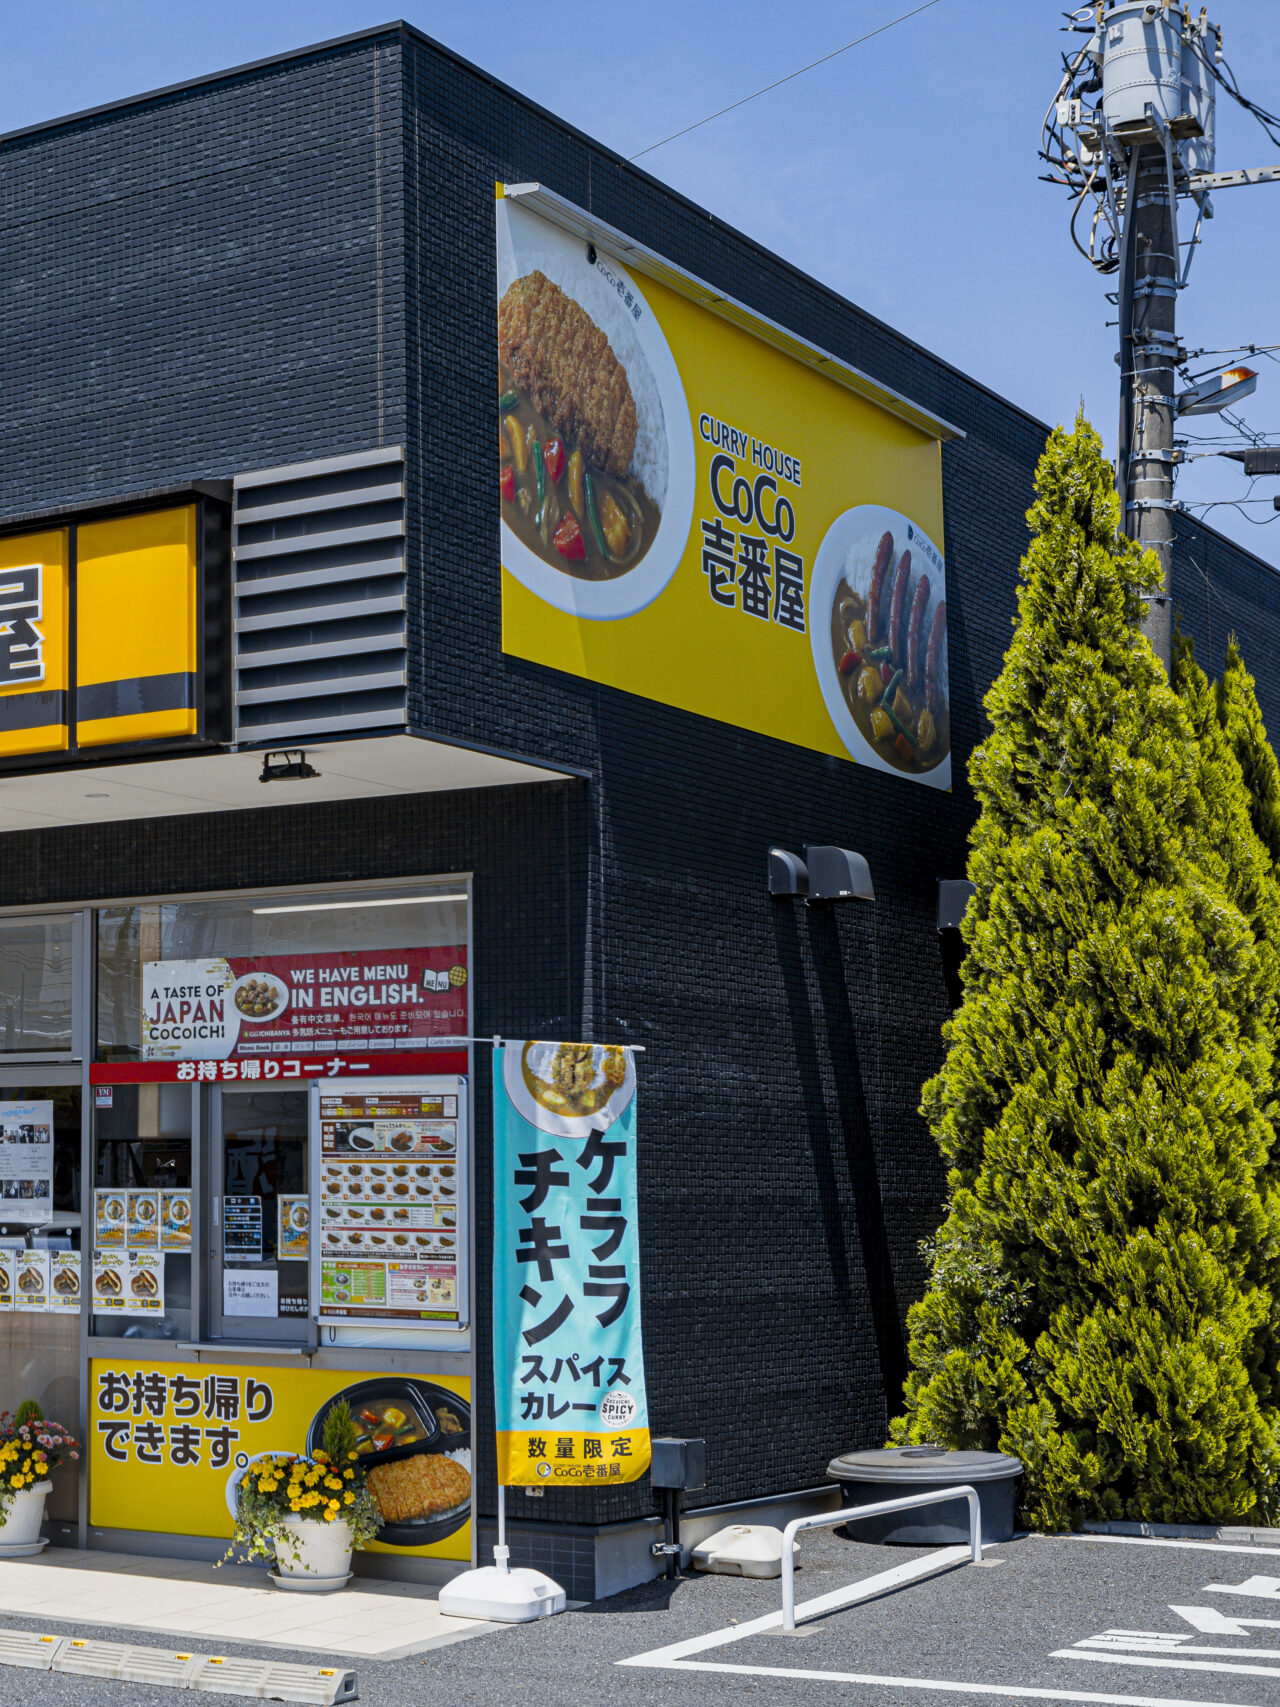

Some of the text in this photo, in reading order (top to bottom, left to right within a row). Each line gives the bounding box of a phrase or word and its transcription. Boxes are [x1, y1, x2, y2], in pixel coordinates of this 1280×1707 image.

[700, 414, 801, 486] CURRY HOUSE
[710, 453, 794, 543] CoCo
[701, 516, 805, 634] 壱番屋
[291, 964, 408, 983] WE HAVE MENU
[151, 985, 224, 999] A TASTE OF
[292, 983, 424, 1008] IN ENGLISH.
[150, 1000, 224, 1025] JAPAN
[177, 1057, 370, 1081] お持ち帰りコーナー
[576, 1127, 630, 1328] ケララ
[514, 1147, 575, 1348] チキン
[520, 1353, 632, 1388] スパイス
[97, 1370, 274, 1422] お持ち帰り
[521, 1392, 596, 1420] カレー
[602, 1403, 634, 1415] SPICY
[98, 1419, 249, 1469] できます。
[528, 1437, 632, 1459] 数量限定
[554, 1463, 621, 1478] CoCo壱番屋
